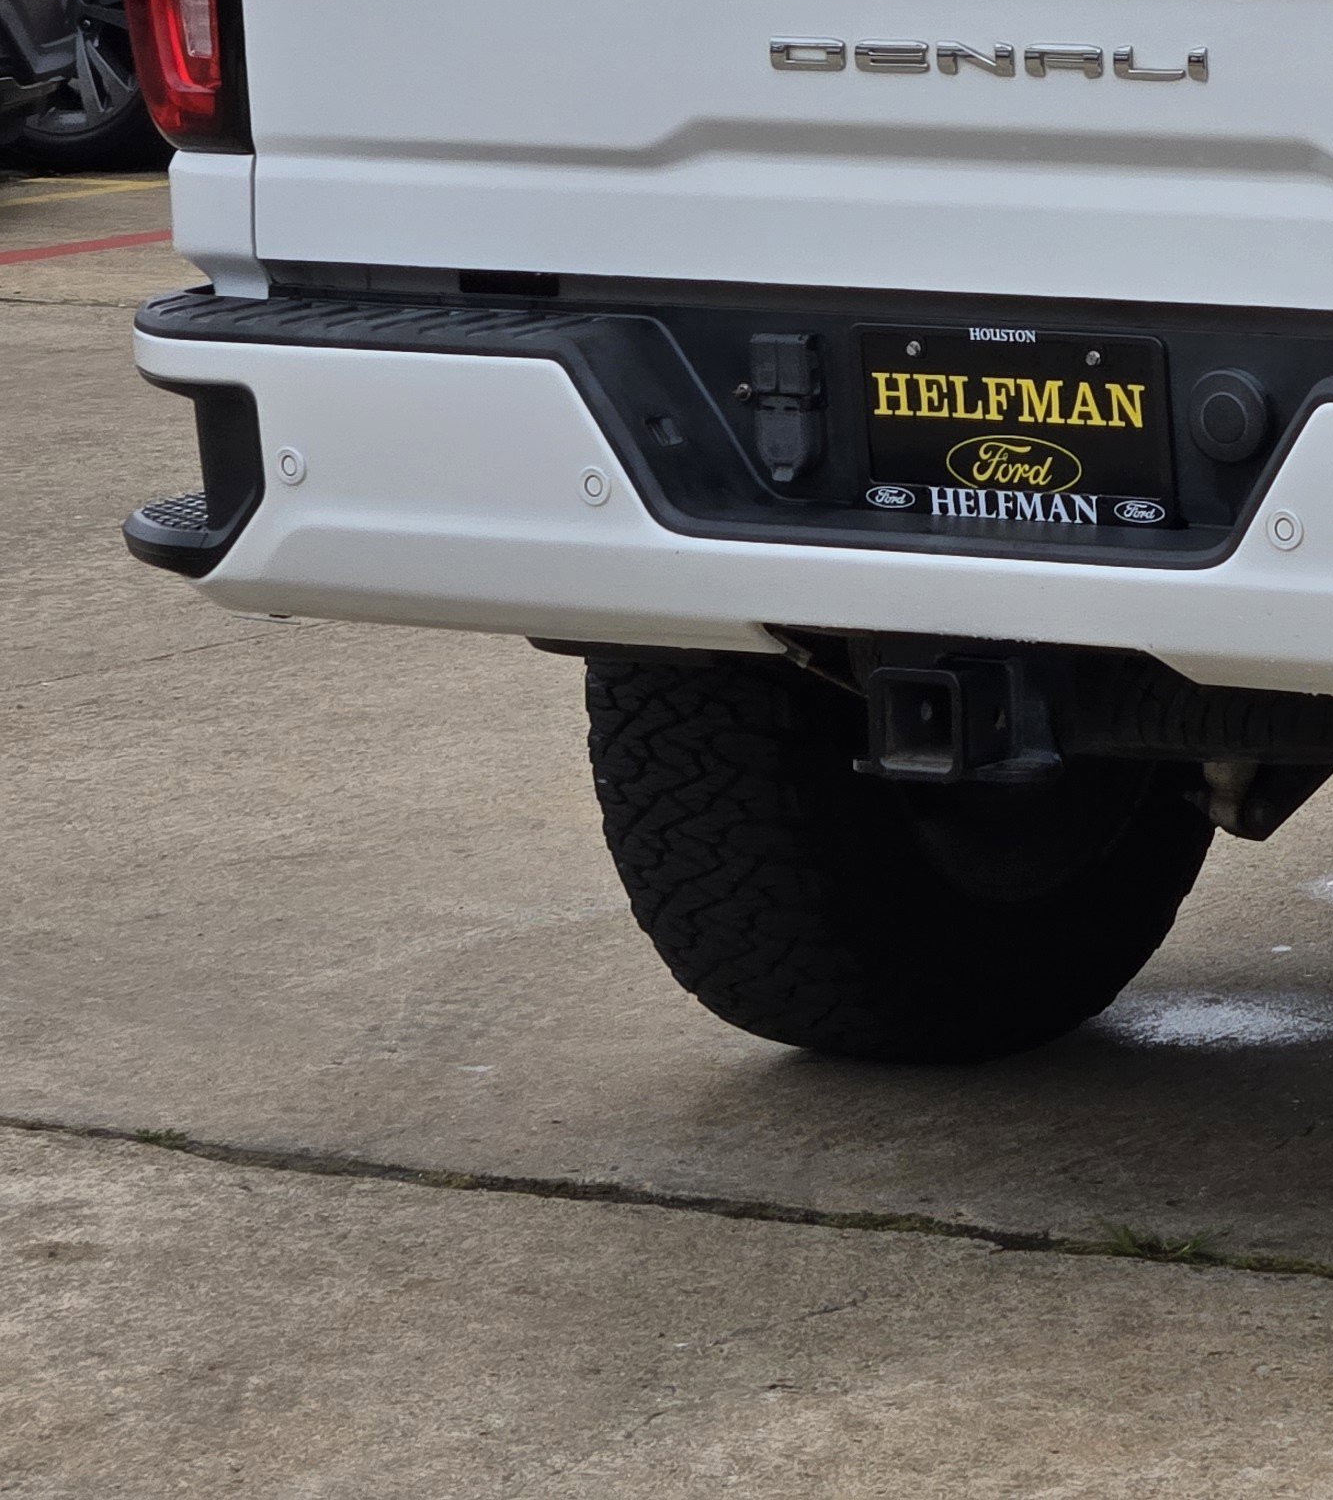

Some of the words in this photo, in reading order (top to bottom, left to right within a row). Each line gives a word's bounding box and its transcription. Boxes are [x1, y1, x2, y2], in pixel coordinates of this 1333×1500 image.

[770, 35, 1209, 82] DENALI
[969, 327, 1036, 343] HOUSTON
[871, 371, 1146, 429] HELFMAN
[972, 441, 1053, 486] Ford
[929, 486, 1098, 526] HELFMAN
